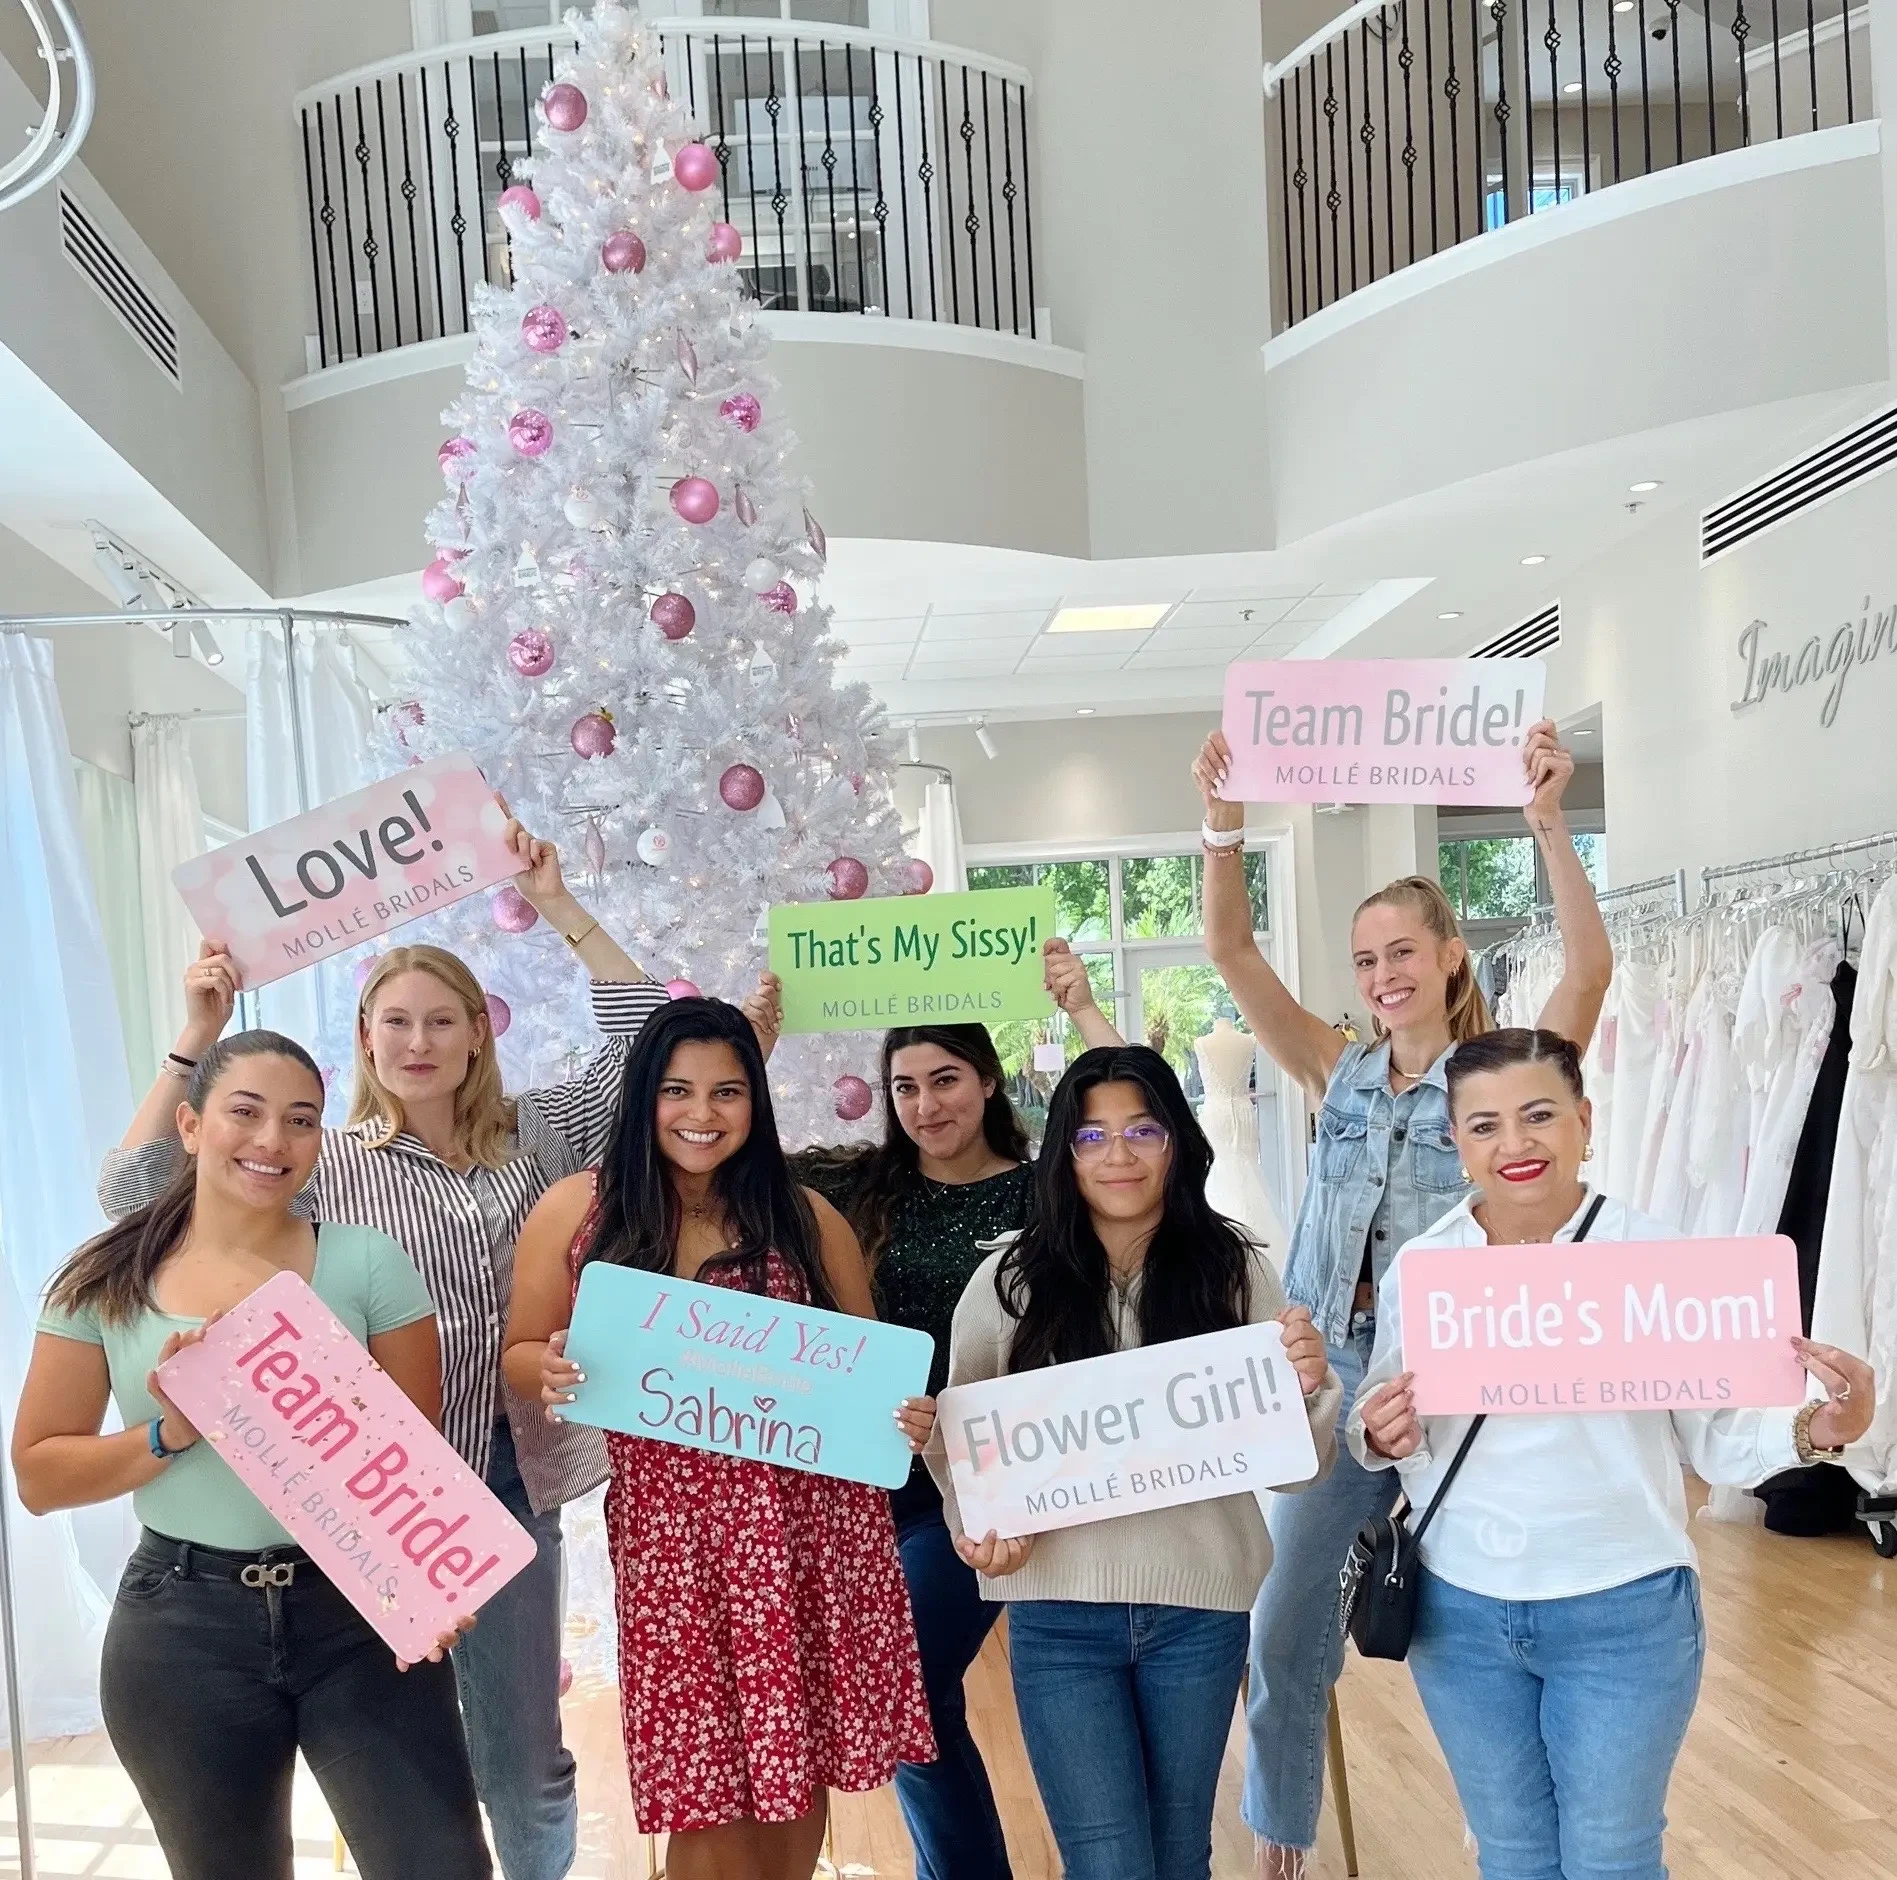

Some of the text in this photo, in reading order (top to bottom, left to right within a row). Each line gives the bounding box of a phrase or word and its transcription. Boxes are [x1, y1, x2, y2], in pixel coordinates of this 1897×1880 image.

[1245, 685, 1525, 747] Team Bride!
[1276, 762, 1476, 787] MOLLÉ BRIDALS
[245, 789, 444, 918] Love!
[282, 864, 474, 960] MOLLÉ BRIDALS
[787, 916, 1037, 971] That's My Sissy!
[823, 991, 1002, 1018] MOLLÉ BRIDALS
[639, 1291, 868, 1374] I Said Yes!
[1427, 1279, 1777, 1350] Bride's Mom!
[638, 1367, 822, 1465] Sabrina
[962, 1356, 1282, 1473] Flower Girl!
[1480, 1377, 1732, 1406] MOLLÉ BRIDALS
[236, 1311, 501, 1603] Team Bride!
[1025, 1452, 1249, 1516] MOLLÉ BRIDALS
[223, 1403, 399, 1598] MOLLÉ BRIDALS
